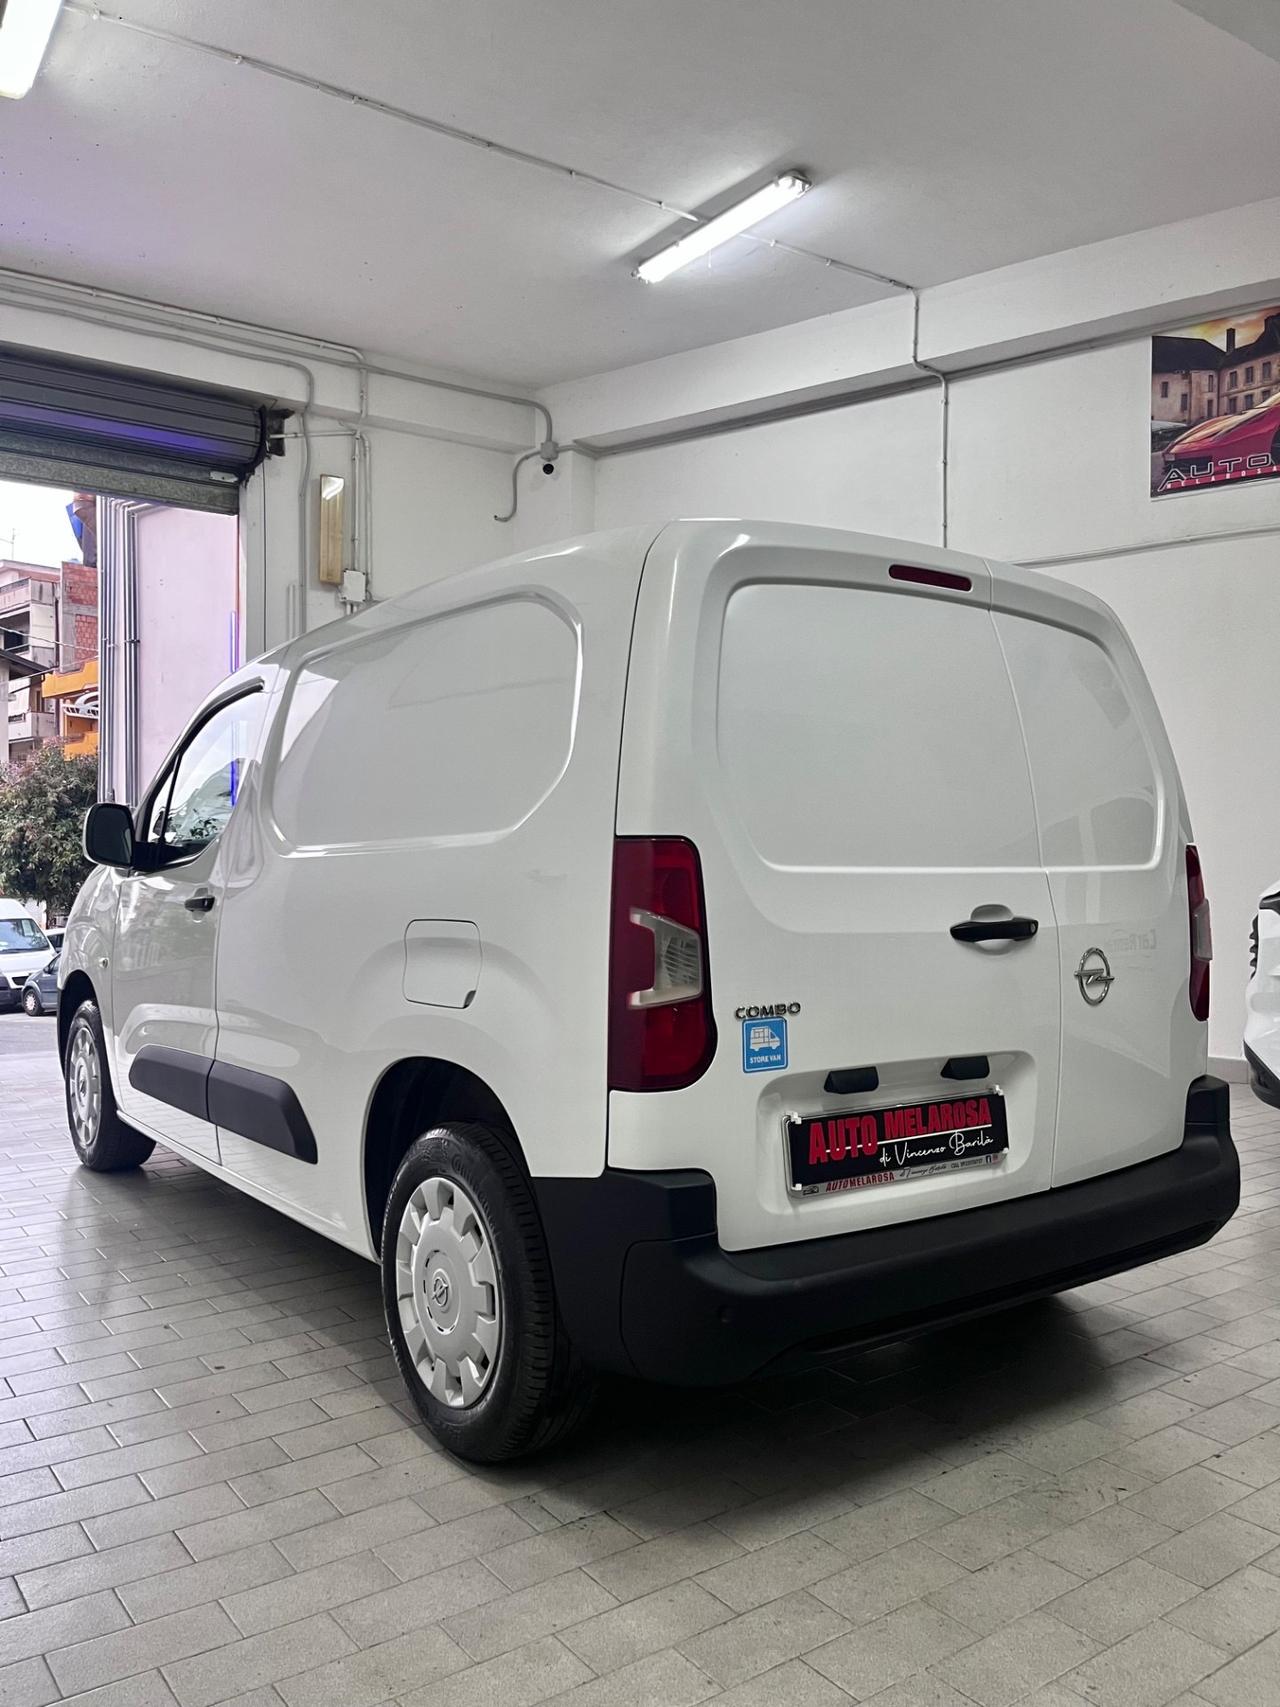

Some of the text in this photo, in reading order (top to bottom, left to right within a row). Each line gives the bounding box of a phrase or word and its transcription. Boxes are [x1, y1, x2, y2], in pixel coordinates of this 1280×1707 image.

[1157, 453, 1271, 492] AUTO
[1166, 466, 1277, 489] MELAROSA
[735, 1002, 801, 1020] COMBO
[750, 1054, 781, 1064] STORE VAN
[809, 1098, 993, 1165] AUTO MELAROSA
[879, 1147, 892, 1168] di
[894, 1142, 947, 1166] Vincenzo
[948, 1129, 994, 1156] Barilà
[825, 1171, 895, 1192] AUTOMELAROSA
